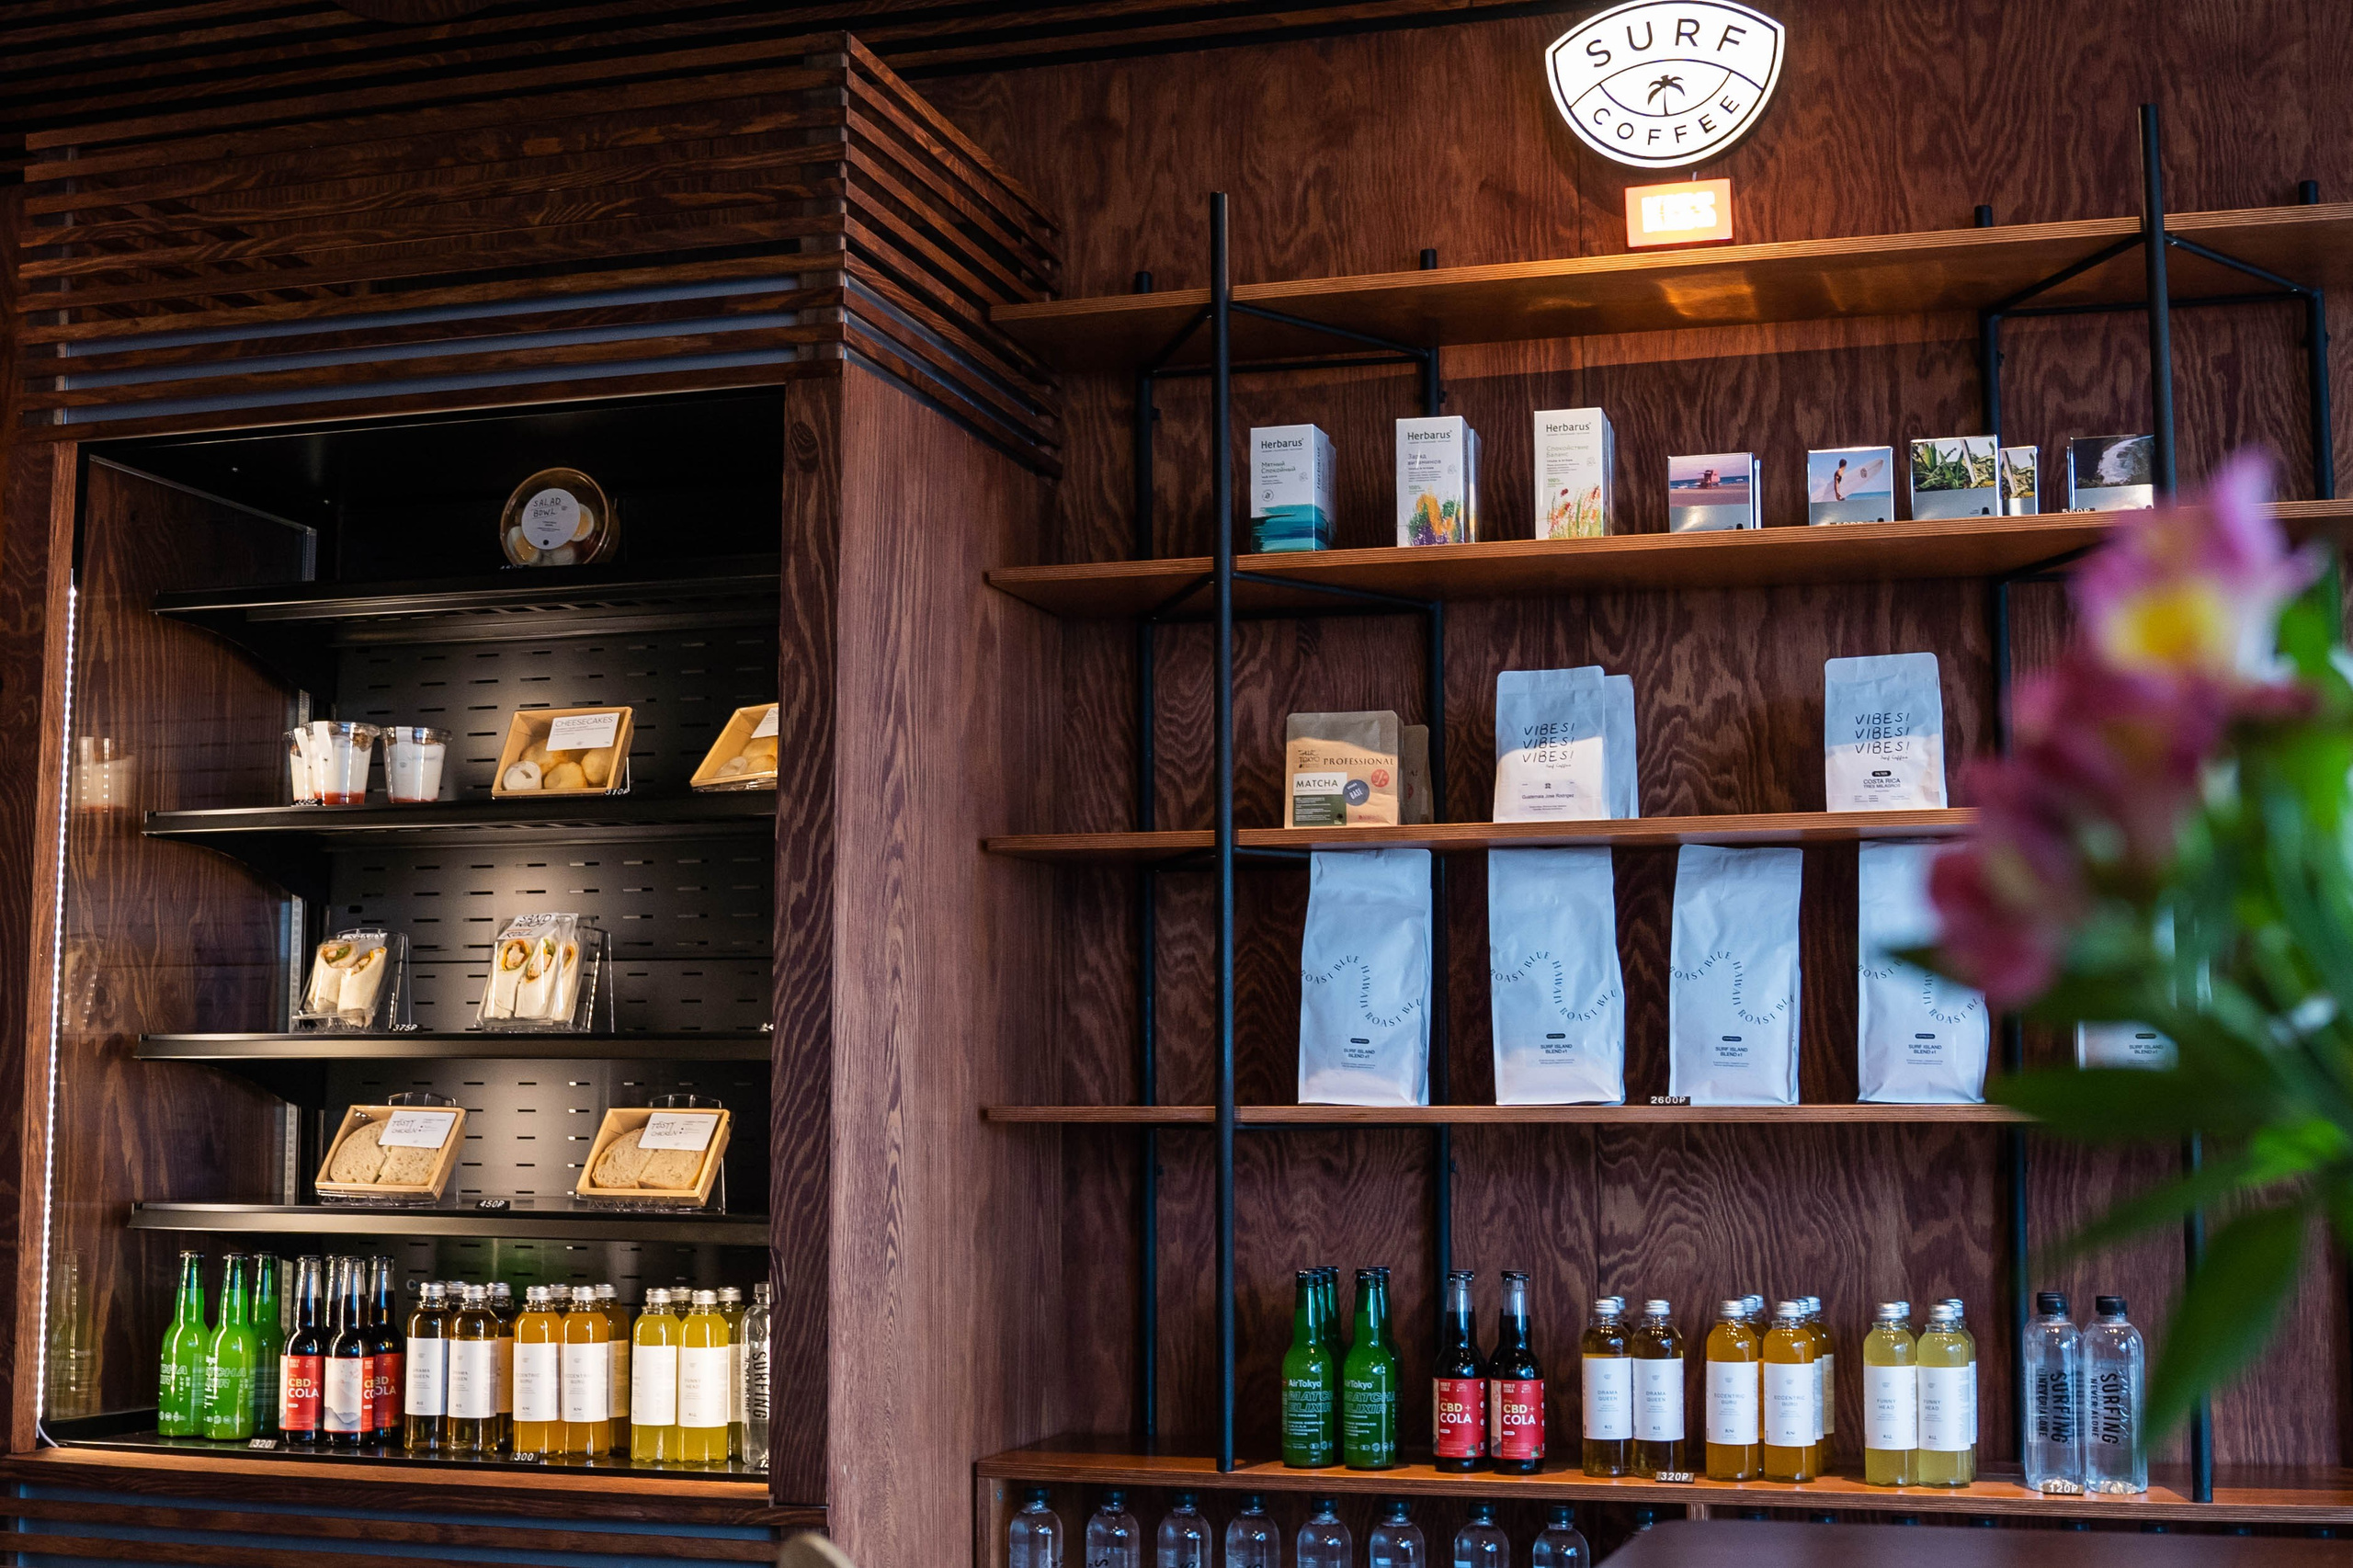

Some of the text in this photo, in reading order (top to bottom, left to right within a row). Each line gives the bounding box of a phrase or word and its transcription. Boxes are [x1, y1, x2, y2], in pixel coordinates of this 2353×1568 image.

[1586, 18, 1746, 67] SURF
[1593, 96, 1740, 145] COFFEE
[1546, 423, 1590, 433] Herbarus
[1407, 431, 1451, 440] Herbarus
[1261, 438, 1303, 449] Herbarus
[533, 497, 562, 507] SALAD
[532, 508, 556, 517] BOWL
[555, 716, 613, 727] CHEESECAKES
[1855, 712, 1910, 725] VIBES!
[1524, 722, 1574, 735] VIBES!
[1855, 726, 1910, 739] VIBES!
[1523, 736, 1574, 749] VIBES!
[1855, 741, 1910, 754] VIBES!
[1324, 756, 1394, 766] PROFESSIONAL
[1522, 750, 1574, 763] VIBES!
[1296, 779, 1338, 788] MATCHA
[1334, 955, 1359, 971] BLUE
[1359, 965, 1370, 1008] HAWAII
[1365, 1012, 1401, 1028] ROAST
[1524, 951, 1550, 968] BLUE
[1552, 960, 1563, 1004] HAWAII
[1560, 1007, 1597, 1021] ROAST
[1704, 951, 1731, 967] BLUE
[1733, 960, 1743, 1006] HAWAII
[1738, 1009, 1775, 1025] ROAST
[1928, 1008, 1966, 1024] ROAST
[289, 1379, 311, 1388] CBD
[751, 1351, 769, 1420] SURFING
[1289, 1380, 1322, 1389] AirTokyo
[288, 1388, 319, 1398] COLA
[1439, 1403, 1463, 1413] CBD
[1503, 1404, 1528, 1414] CBD
[2050, 1372, 2071, 1444] SURFING
[2090, 1378, 2099, 1438] NEVER ALONE
[2100, 1373, 2120, 1445] SURFING
[1439, 1413, 1472, 1424] COLA
[1503, 1414, 1536, 1425] COLA
